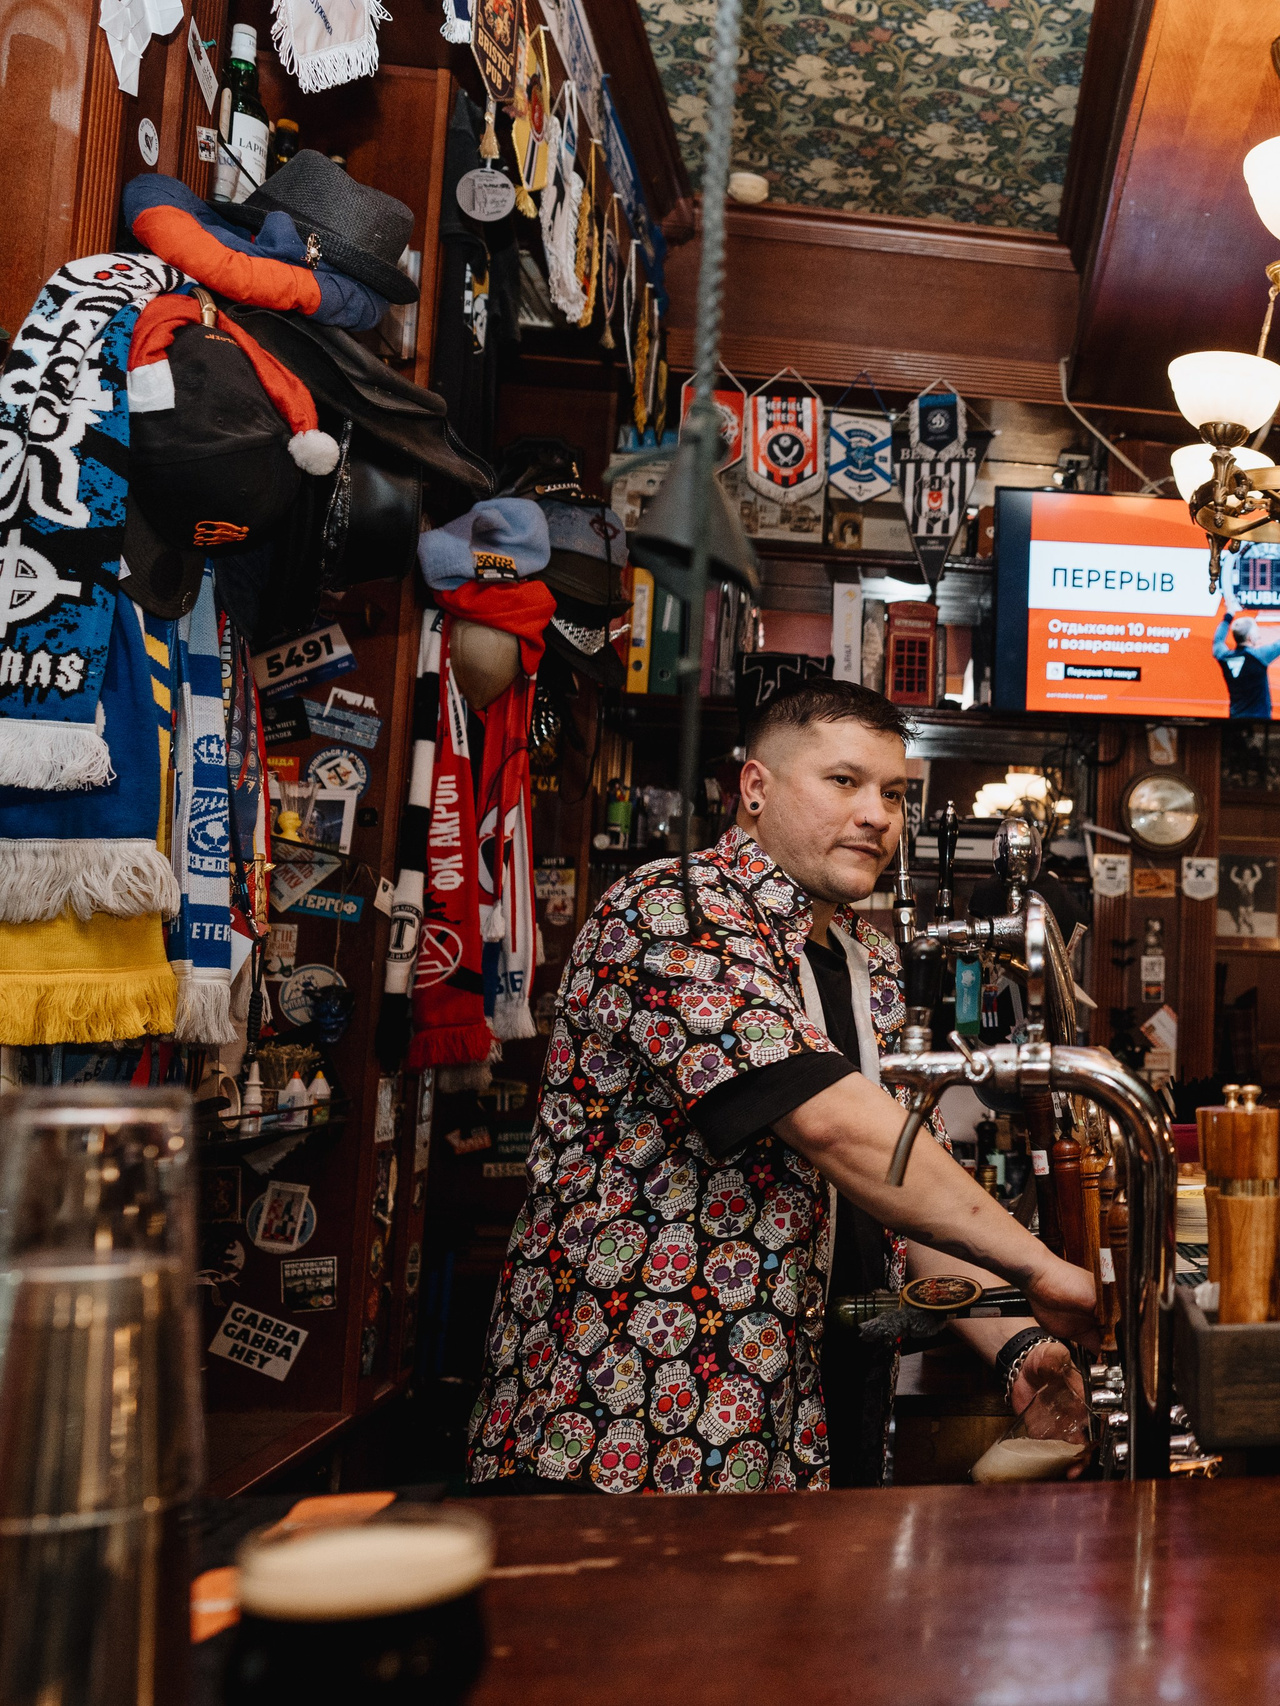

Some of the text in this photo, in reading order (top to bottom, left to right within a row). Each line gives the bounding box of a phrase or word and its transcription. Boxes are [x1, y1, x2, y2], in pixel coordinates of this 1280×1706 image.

[477, 28, 512, 83] BRISTOL
[485, 58, 502, 91] PUB
[239, 137, 268, 159] LAPH
[1053, 567, 1174, 592] ПЕРЕРЫВ
[1048, 618, 1191, 641] Отдыхаем 10 минут
[266, 633, 334, 678] 5491
[1048, 638, 1170, 654] и возвращаемся
[294, 894, 358, 915] ТЕРГОФ
[191, 922, 231, 942] ETER
[231, 1307, 300, 1346] GABBA
[223, 1323, 292, 1361] GABBA
[228, 1343, 272, 1369] HEY
